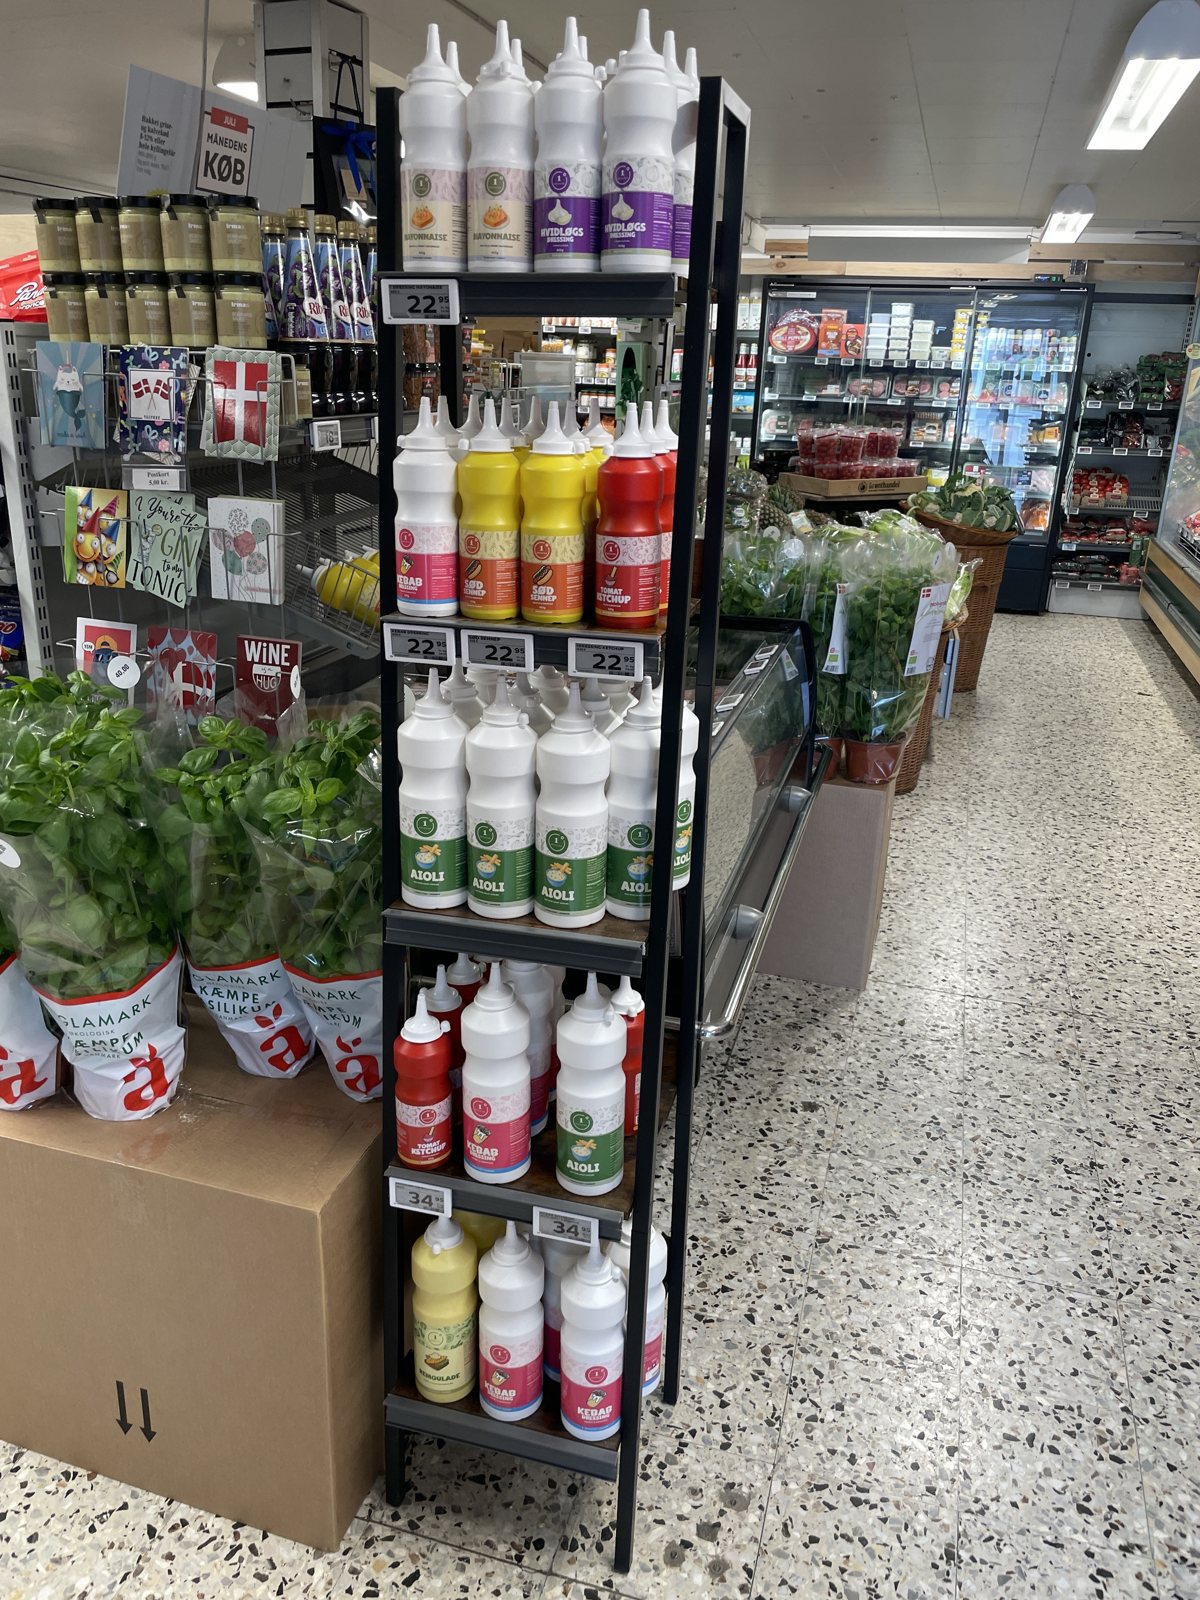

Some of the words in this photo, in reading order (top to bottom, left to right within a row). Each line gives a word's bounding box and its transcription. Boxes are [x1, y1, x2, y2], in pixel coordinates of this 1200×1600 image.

[223, 116, 236, 127] JULI
[206, 132, 248, 153] MÅNEDENS
[203, 150, 246, 185] KØB
[540, 227, 584, 237] HVIDLØGS
[604, 222, 646, 233] HVIDLØGS
[473, 232, 521, 241] MAYONNAISE
[407, 295, 437, 314] 22
[147, 497, 181, 524] You're
[161, 528, 198, 568] GIN
[162, 559, 171, 573] to
[133, 559, 187, 603] TONIC
[530, 593, 557, 602] SENNEP
[532, 585, 554, 595] SØD
[600, 586, 623, 595] TOMAT
[407, 638, 435, 655] 22
[485, 644, 513, 662] 22
[592, 653, 622, 671] 22
[256, 674, 277, 690] HUG
[410, 869, 445, 882] AIOLI
[472, 877, 505, 892] AIOLI
[541, 885, 575, 901] AIOLI
[199, 985, 259, 1004] KÆMPE
[411, 1142, 447, 1155] KETCHUP
[417, 1139, 440, 1149] TOMAT
[466, 1140, 499, 1157] KEBAB
[566, 1159, 600, 1173] AIOLI
[409, 1191, 434, 1207] 34
[553, 1220, 580, 1237] 34
[484, 1380, 516, 1397] KEBAB
